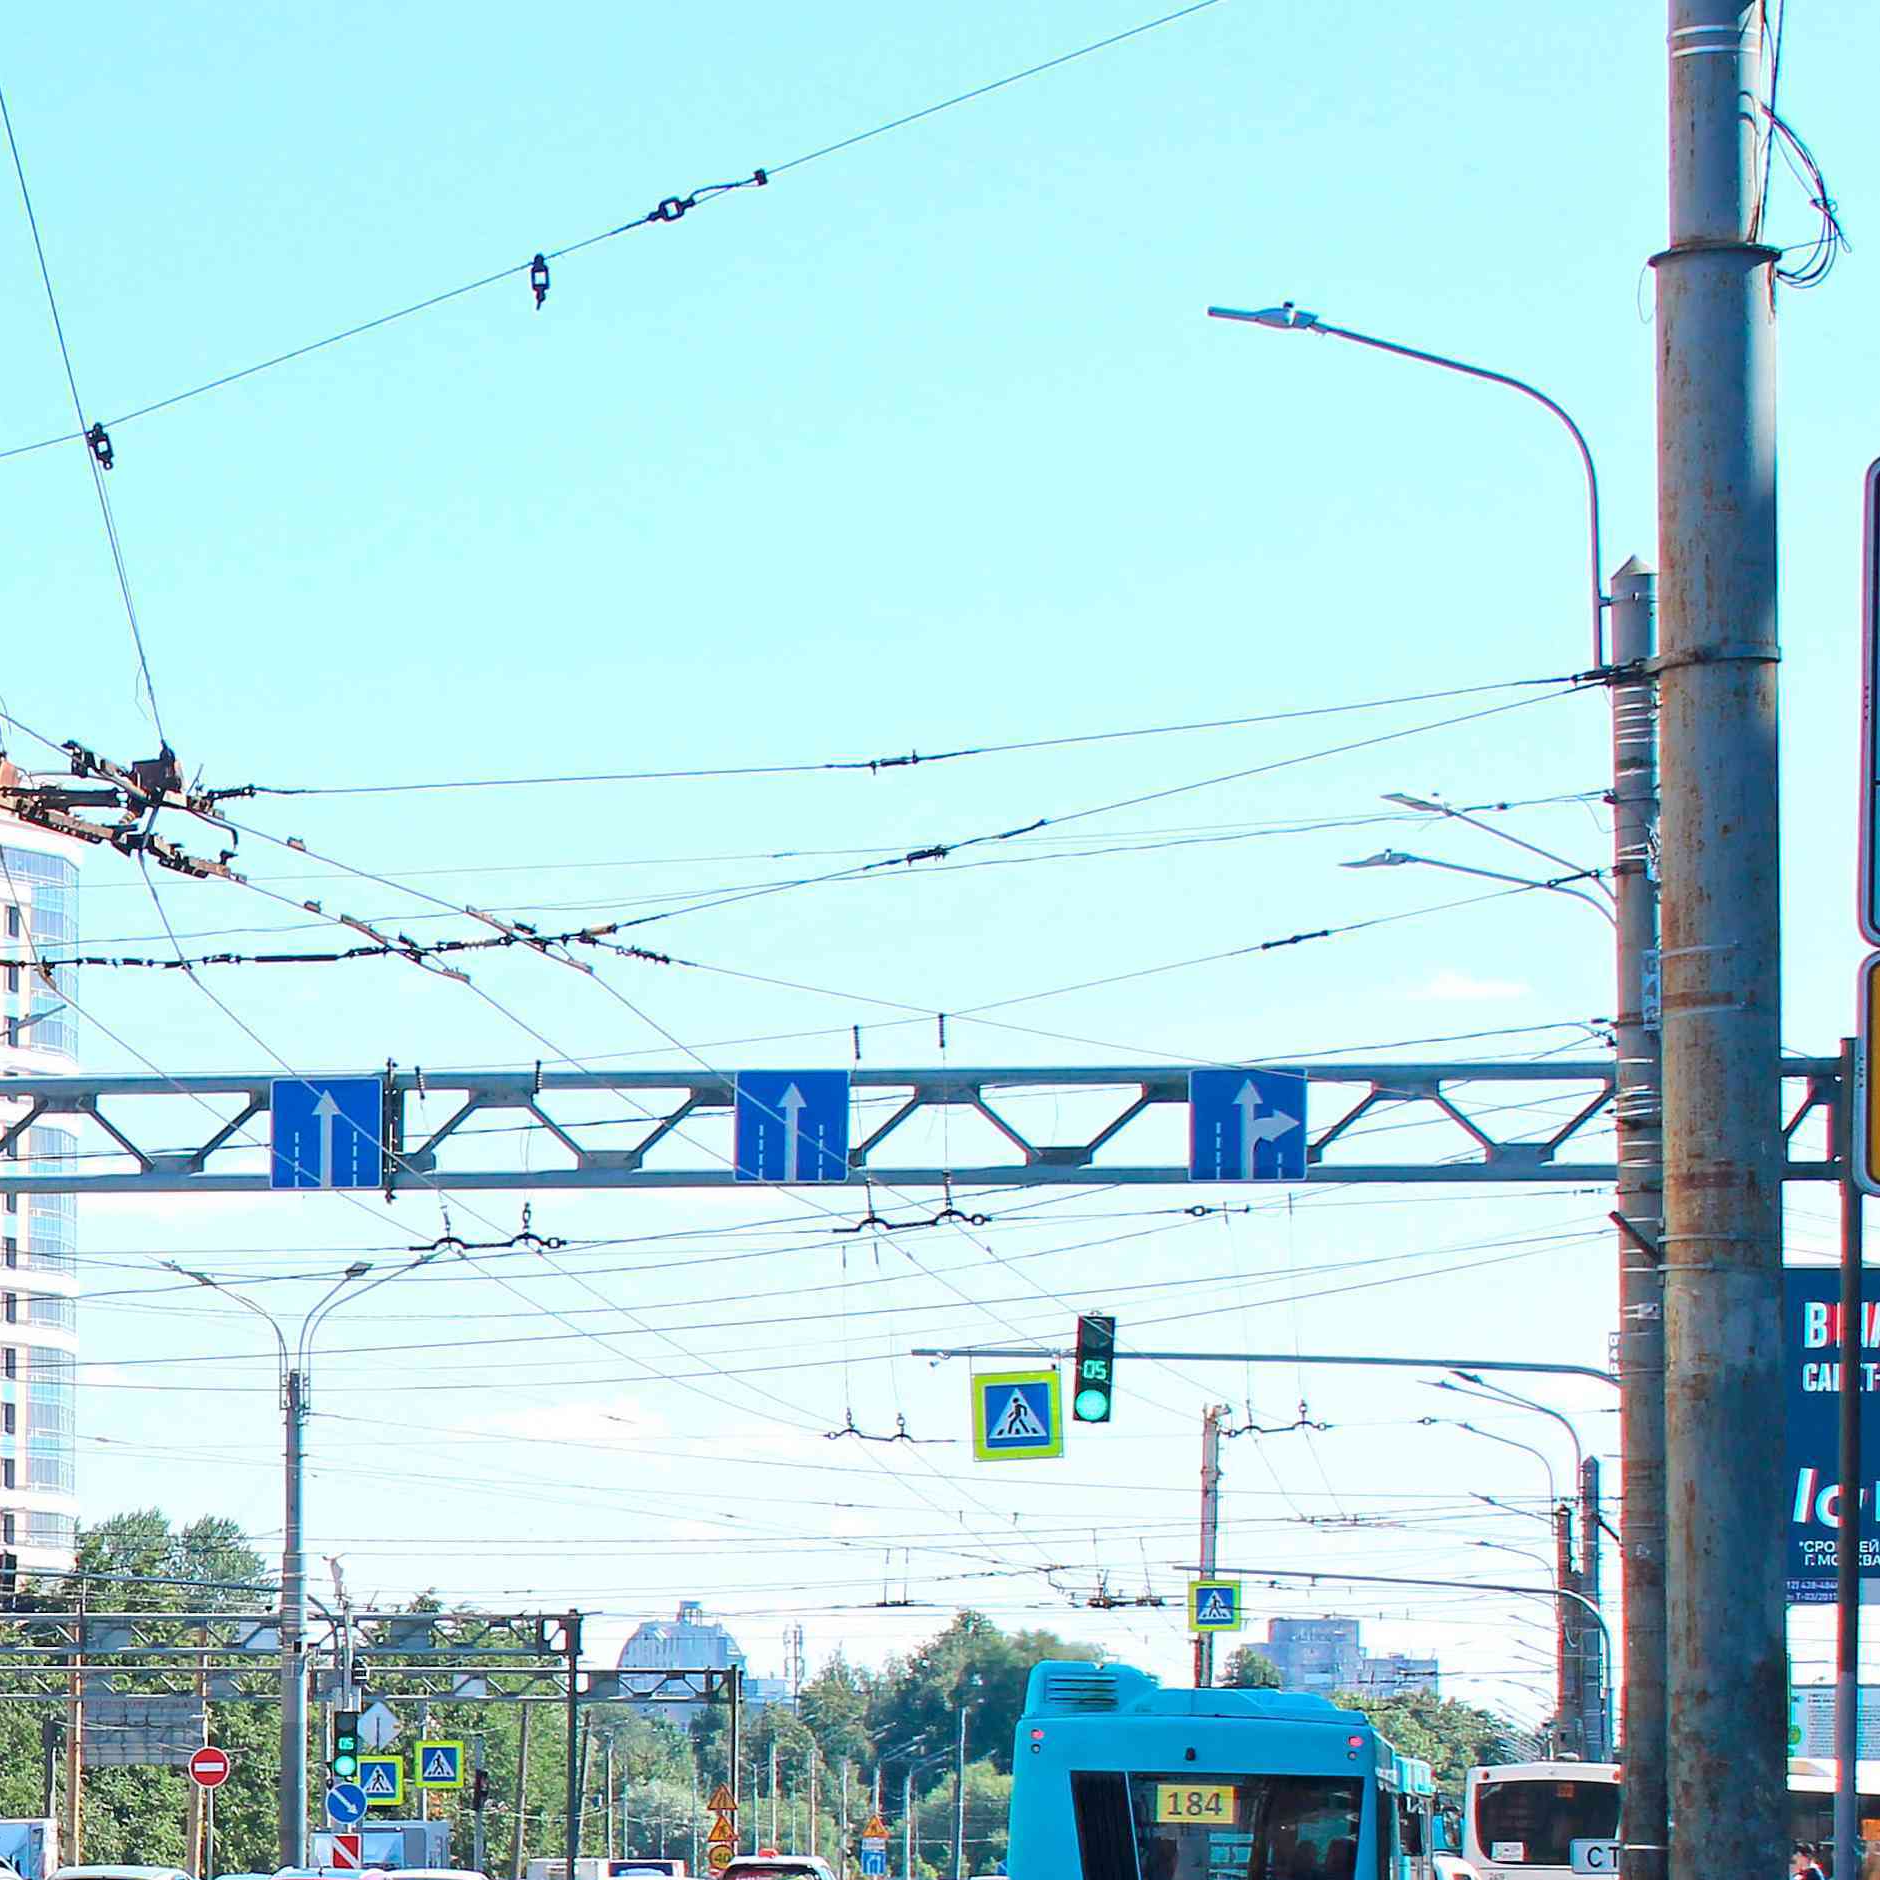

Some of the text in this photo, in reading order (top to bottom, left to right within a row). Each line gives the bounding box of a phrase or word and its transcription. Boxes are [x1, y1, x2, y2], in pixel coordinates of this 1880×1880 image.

[1082, 1360, 1106, 1380] 05
[338, 1737, 354, 1750] 05
[1167, 1791, 1223, 1816] 184
[1587, 1846, 1620, 1868] СТ
